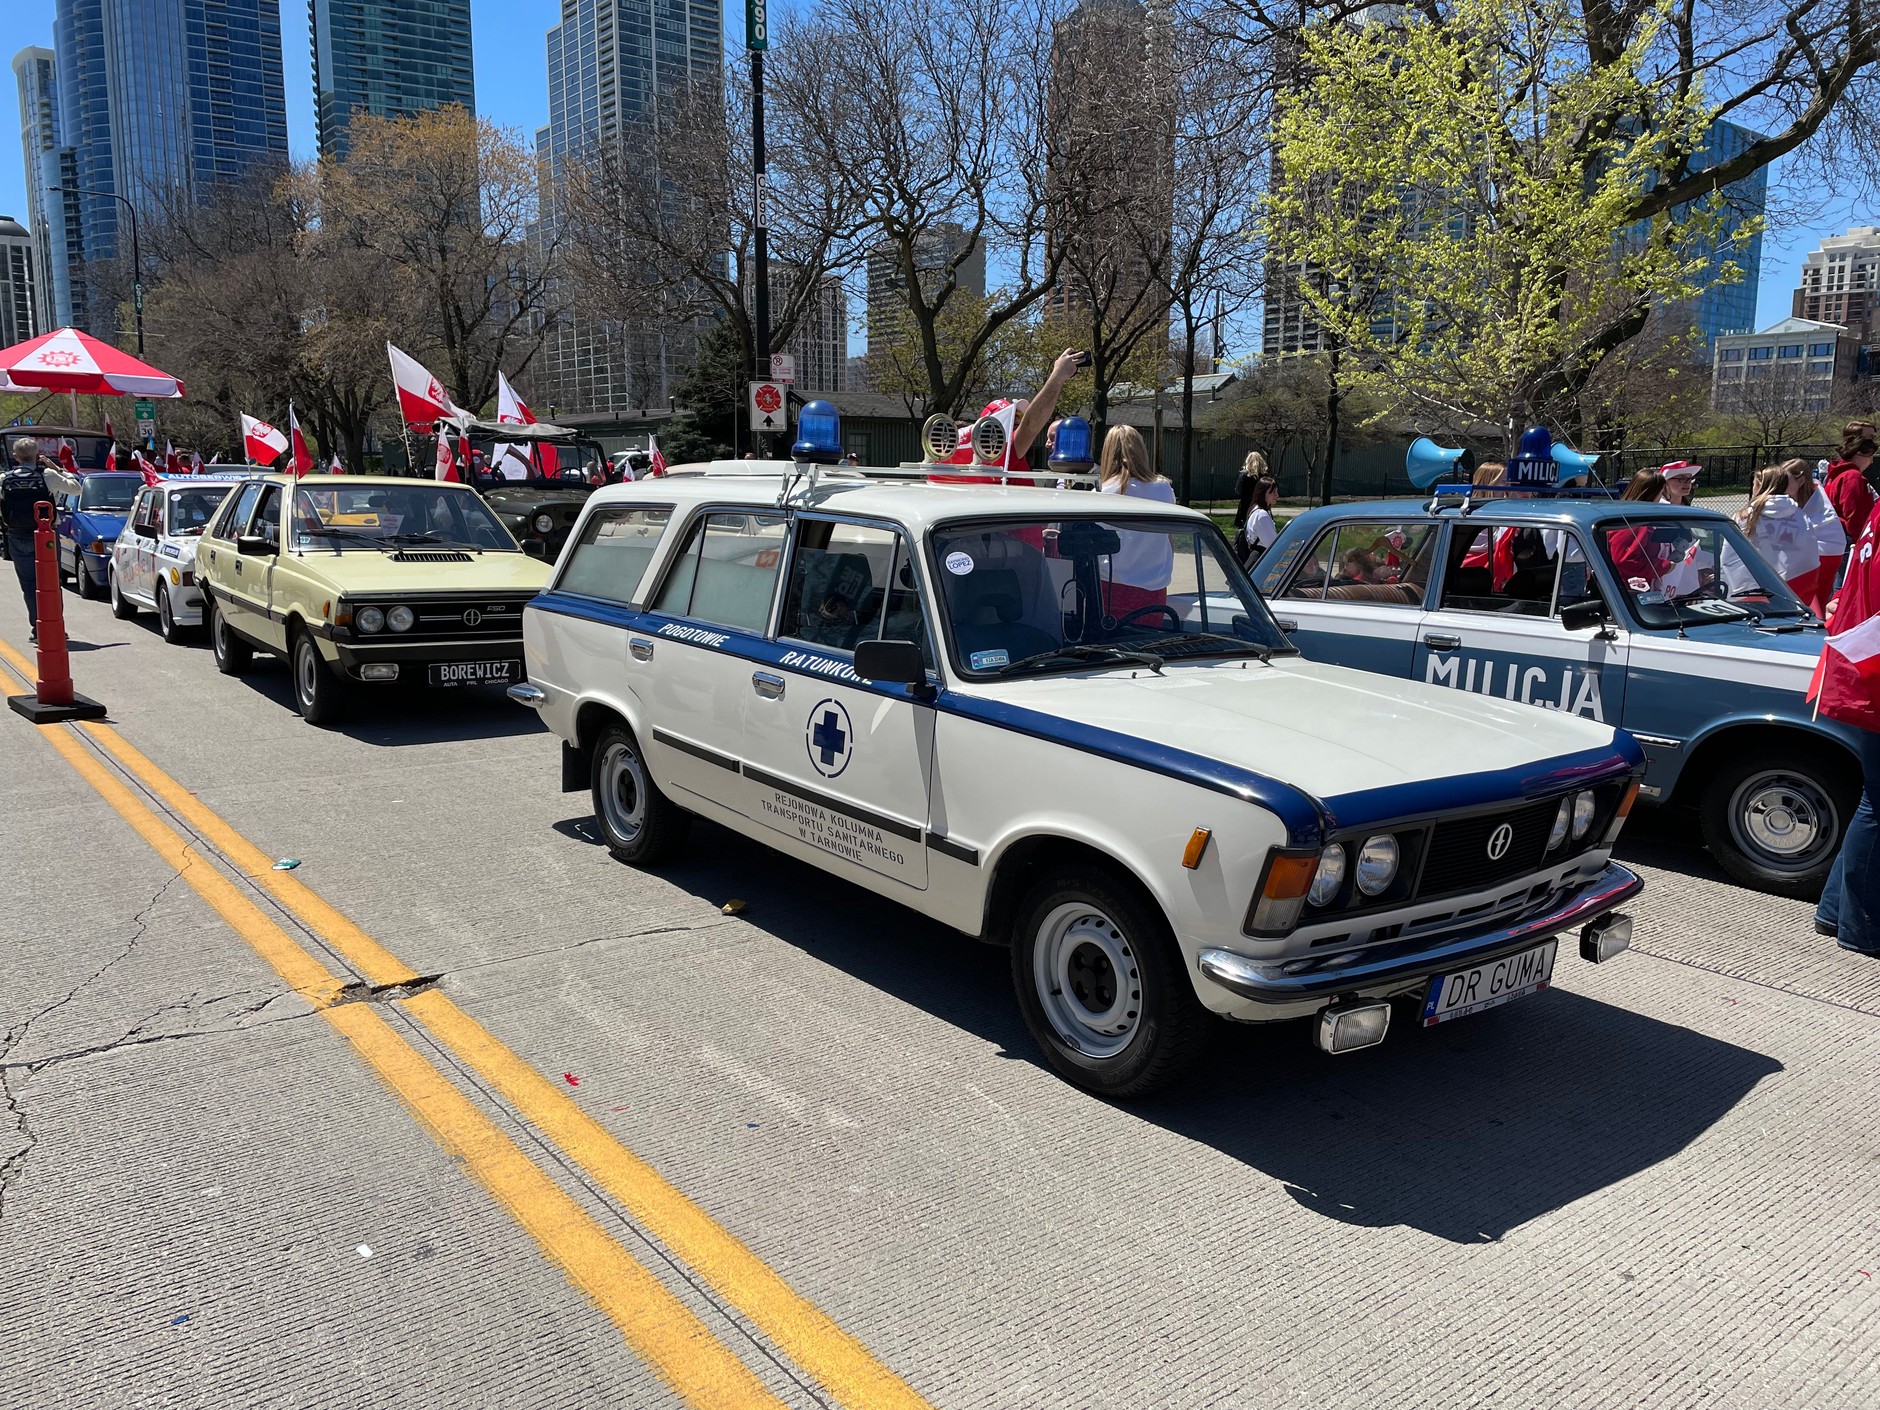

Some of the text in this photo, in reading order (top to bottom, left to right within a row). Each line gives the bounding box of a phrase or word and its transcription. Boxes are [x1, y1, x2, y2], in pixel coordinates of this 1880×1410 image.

[758, 176, 766, 226] C890
[1518, 461, 1560, 482] MILICJ
[948, 560, 972, 570] LOPEZ
[658, 623, 730, 648] POGOTOWIE
[440, 663, 510, 681] BOREWICZ
[779, 651, 873, 685] RATUNKO
[761, 800, 904, 865] TRANSPORTU SANITARNEGO
[775, 792, 883, 843] REJONOWA KOLUMNA
[798, 827, 863, 862] W TARNOWIE
[1446, 969, 1482, 1008] DR
[1490, 947, 1545, 995] GUMA
[1426, 1001, 1435, 1011] PL
